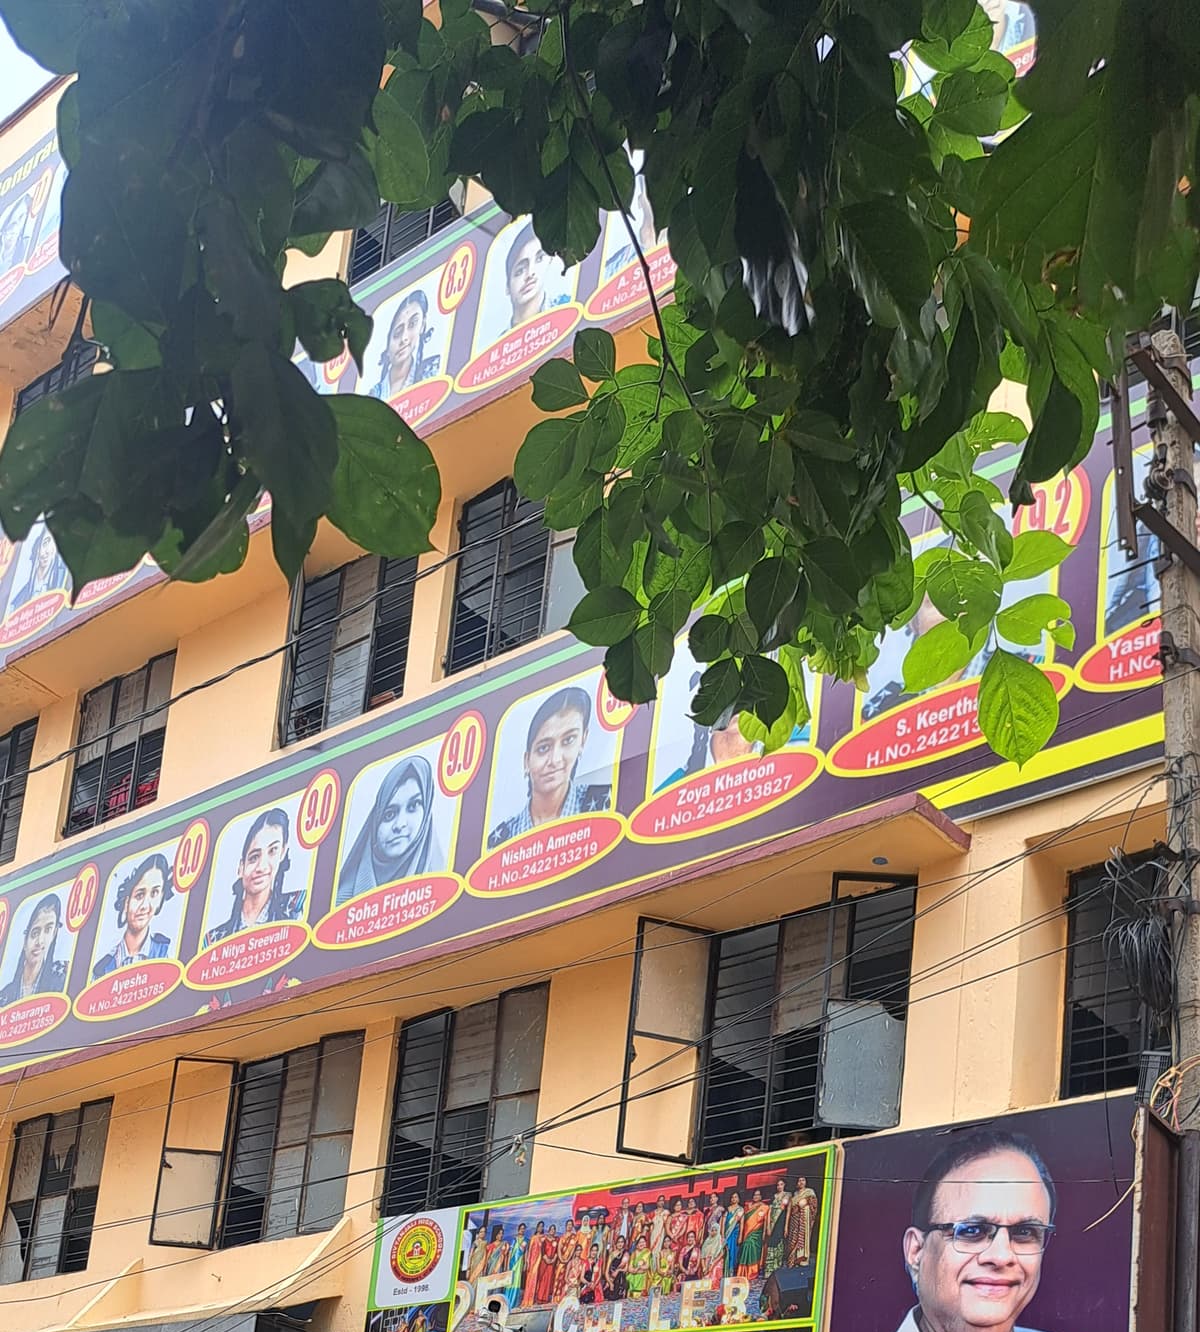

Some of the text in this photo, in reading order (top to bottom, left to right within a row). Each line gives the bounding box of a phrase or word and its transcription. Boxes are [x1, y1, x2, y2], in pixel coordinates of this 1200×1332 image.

[445, 254, 470, 300] 8.3
[502, 336, 522, 357] Ram
[524, 322, 551, 346] Chran
[896, 719, 911, 737] S.
[446, 724, 477, 777] 9.0
[654, 774, 793, 833] H.No.2422133827
[676, 760, 775, 806] Zoya Khatoon
[304, 783, 333, 832] 9.0
[179, 832, 203, 878] 9.0
[488, 841, 598, 890] H.No.2422133219
[501, 824, 592, 868] Nishath Amreen
[70, 875, 93, 919] 8.8
[346, 884, 432, 925] Soha Firdous
[335, 900, 437, 944] H.No.2422134267
[201, 943, 291, 981] H.No.2422135132
[209, 926, 290, 964] A. Nitya Sreevalli
[110, 972, 148, 995] Ayesha
[10, 1002, 51, 1025] Sharanya
